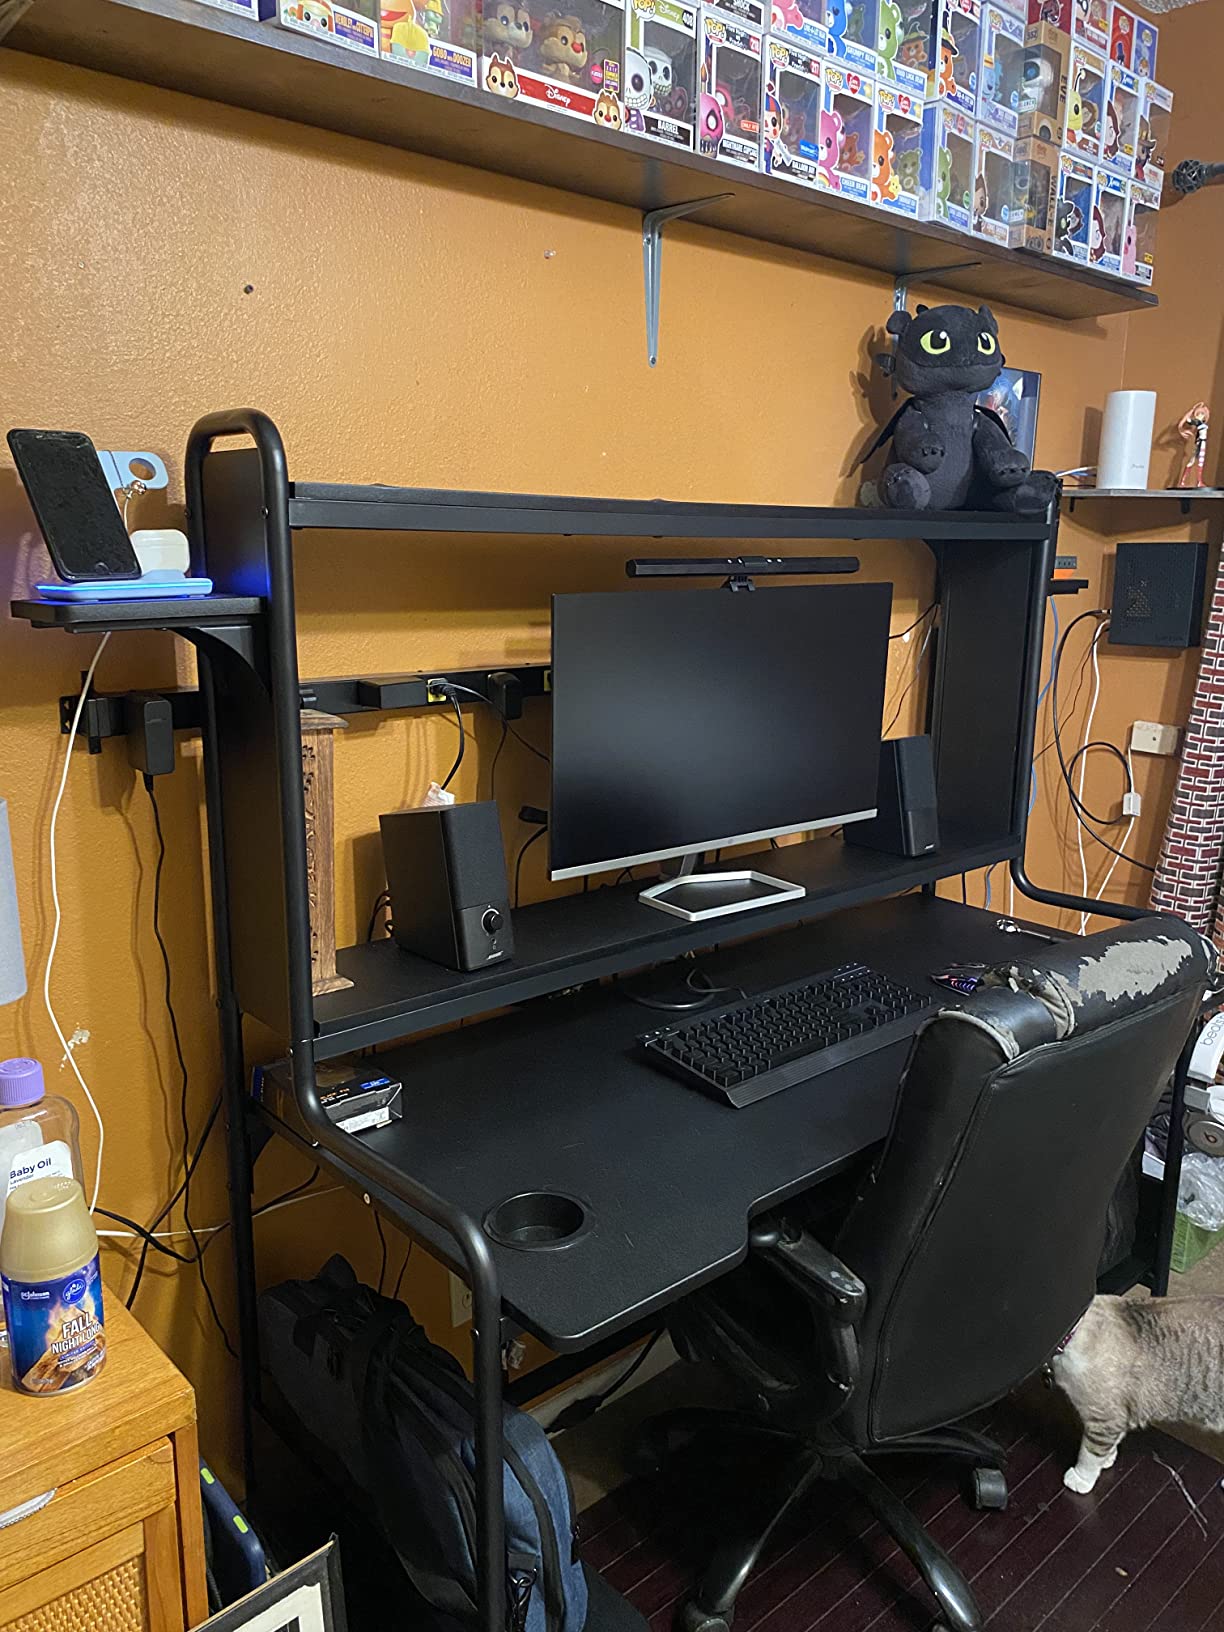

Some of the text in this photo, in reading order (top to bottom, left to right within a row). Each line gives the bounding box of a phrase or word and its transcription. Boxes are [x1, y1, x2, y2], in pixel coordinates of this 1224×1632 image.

[704, 16, 726, 38] POP!
[769, 42, 788, 63] POP!
[544, 84, 571, 108] Disney
[658, 119, 679, 135] BARREL
[10, 1157, 51, 1179] Baby Oil
[62, 1312, 92, 1339] FALL
[51, 1321, 101, 1354] NIGHT LONG
